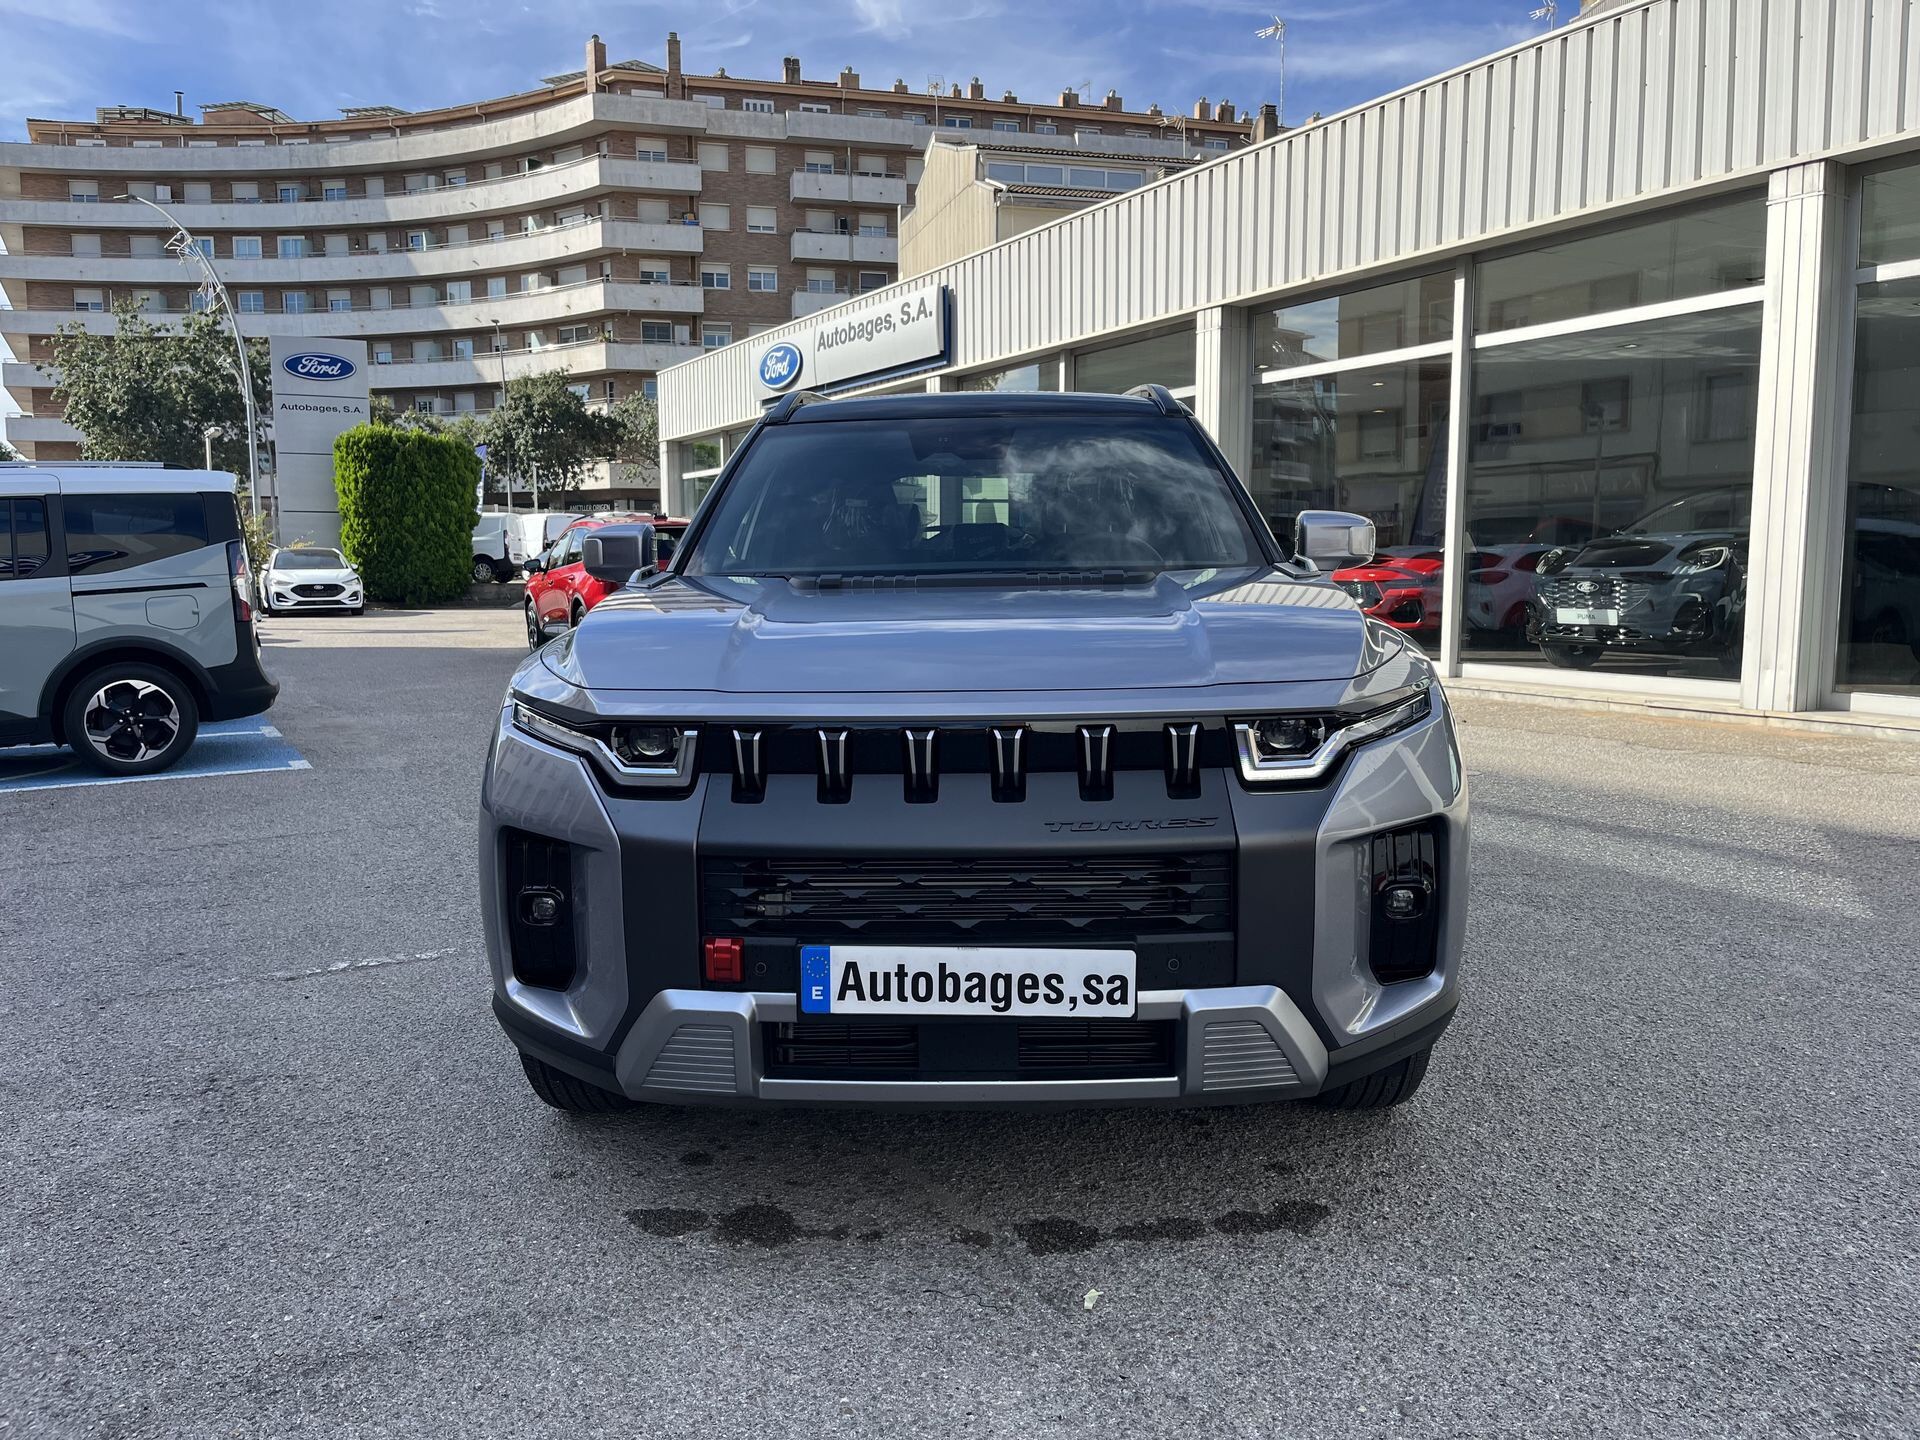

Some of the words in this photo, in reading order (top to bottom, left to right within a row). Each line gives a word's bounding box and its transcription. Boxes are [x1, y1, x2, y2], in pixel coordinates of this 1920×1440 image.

[817, 312, 896, 351] Autobages,
[900, 297, 933, 326] S.A.
[297, 356, 341, 375] Ford
[764, 350, 790, 380] Ford
[280, 403, 341, 414] Autobages,
[343, 405, 364, 414] S.A.
[1044, 816, 1219, 833] TORRES
[811, 986, 824, 1000] E
[836, 960, 1129, 1013] Autobages,sa
